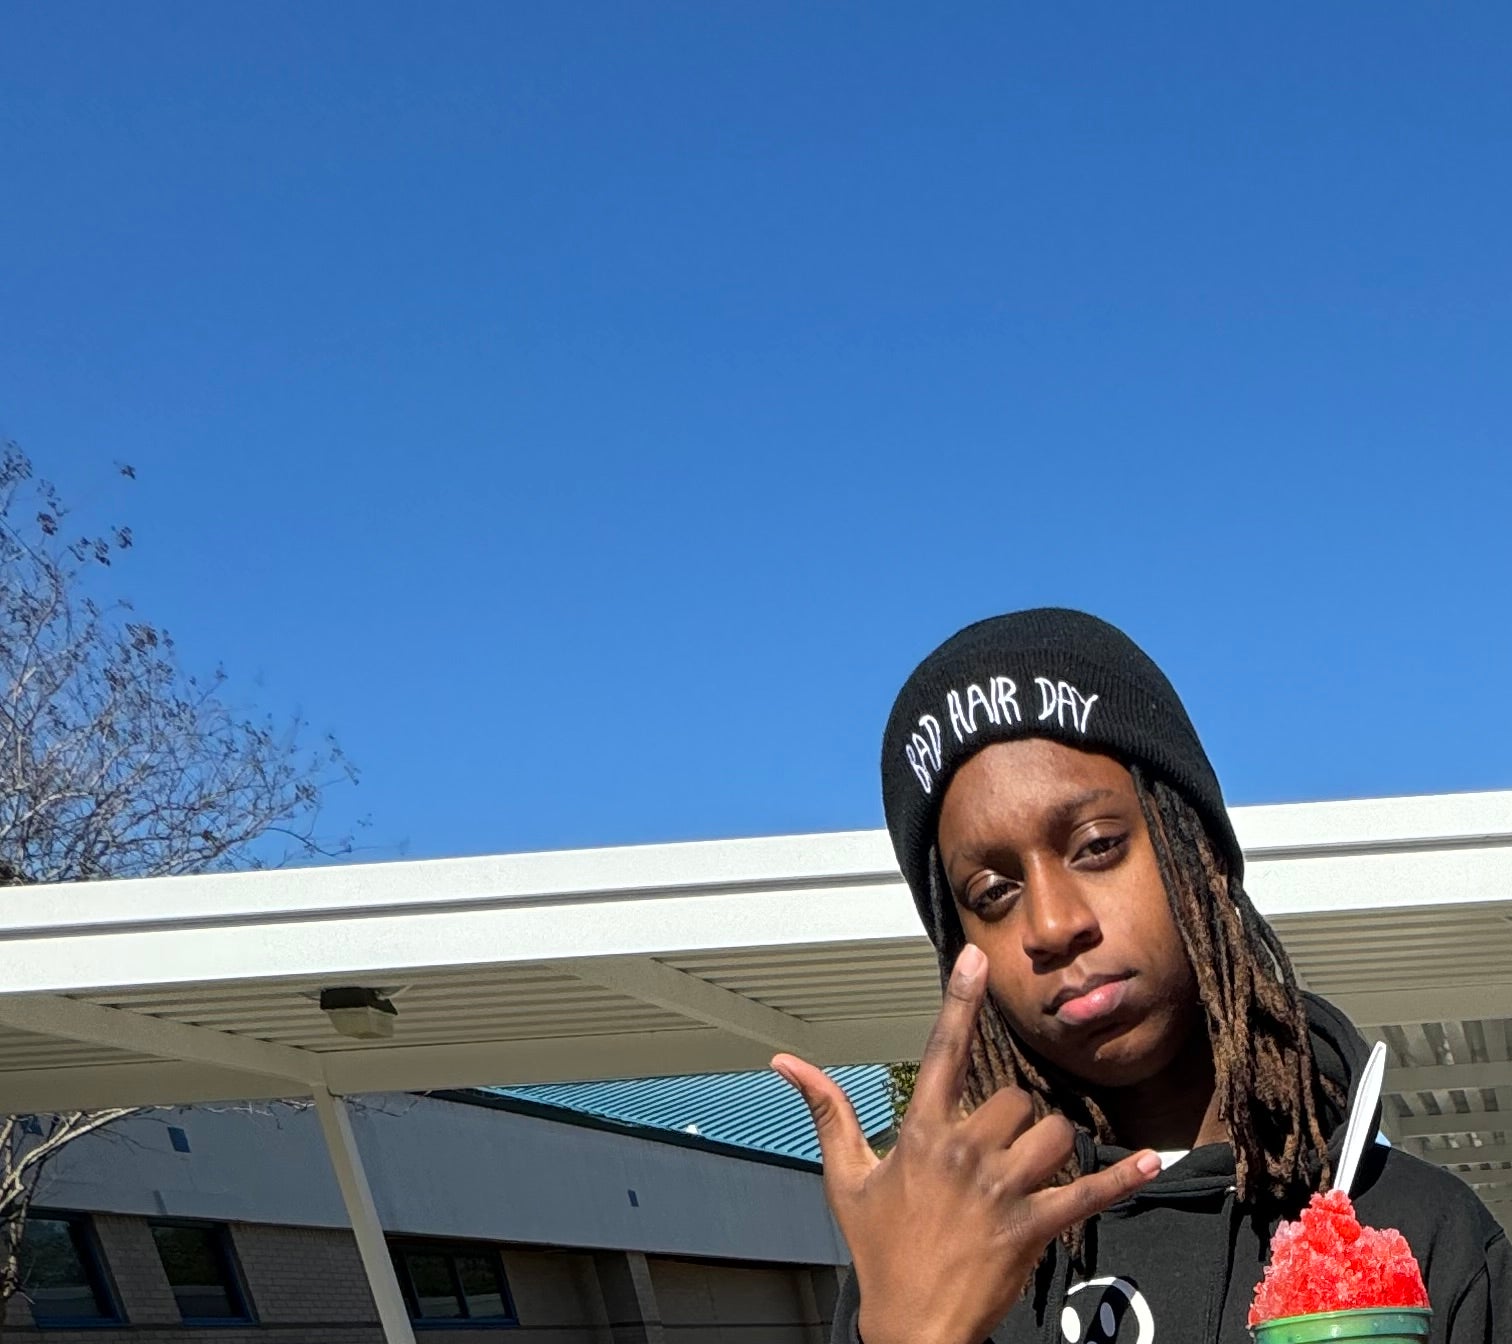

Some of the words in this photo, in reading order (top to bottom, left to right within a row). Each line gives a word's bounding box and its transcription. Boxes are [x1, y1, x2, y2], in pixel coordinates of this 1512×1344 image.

[905, 714, 942, 793] BAD
[947, 675, 1021, 743] HAIR
[1034, 677, 1099, 734] DAY
